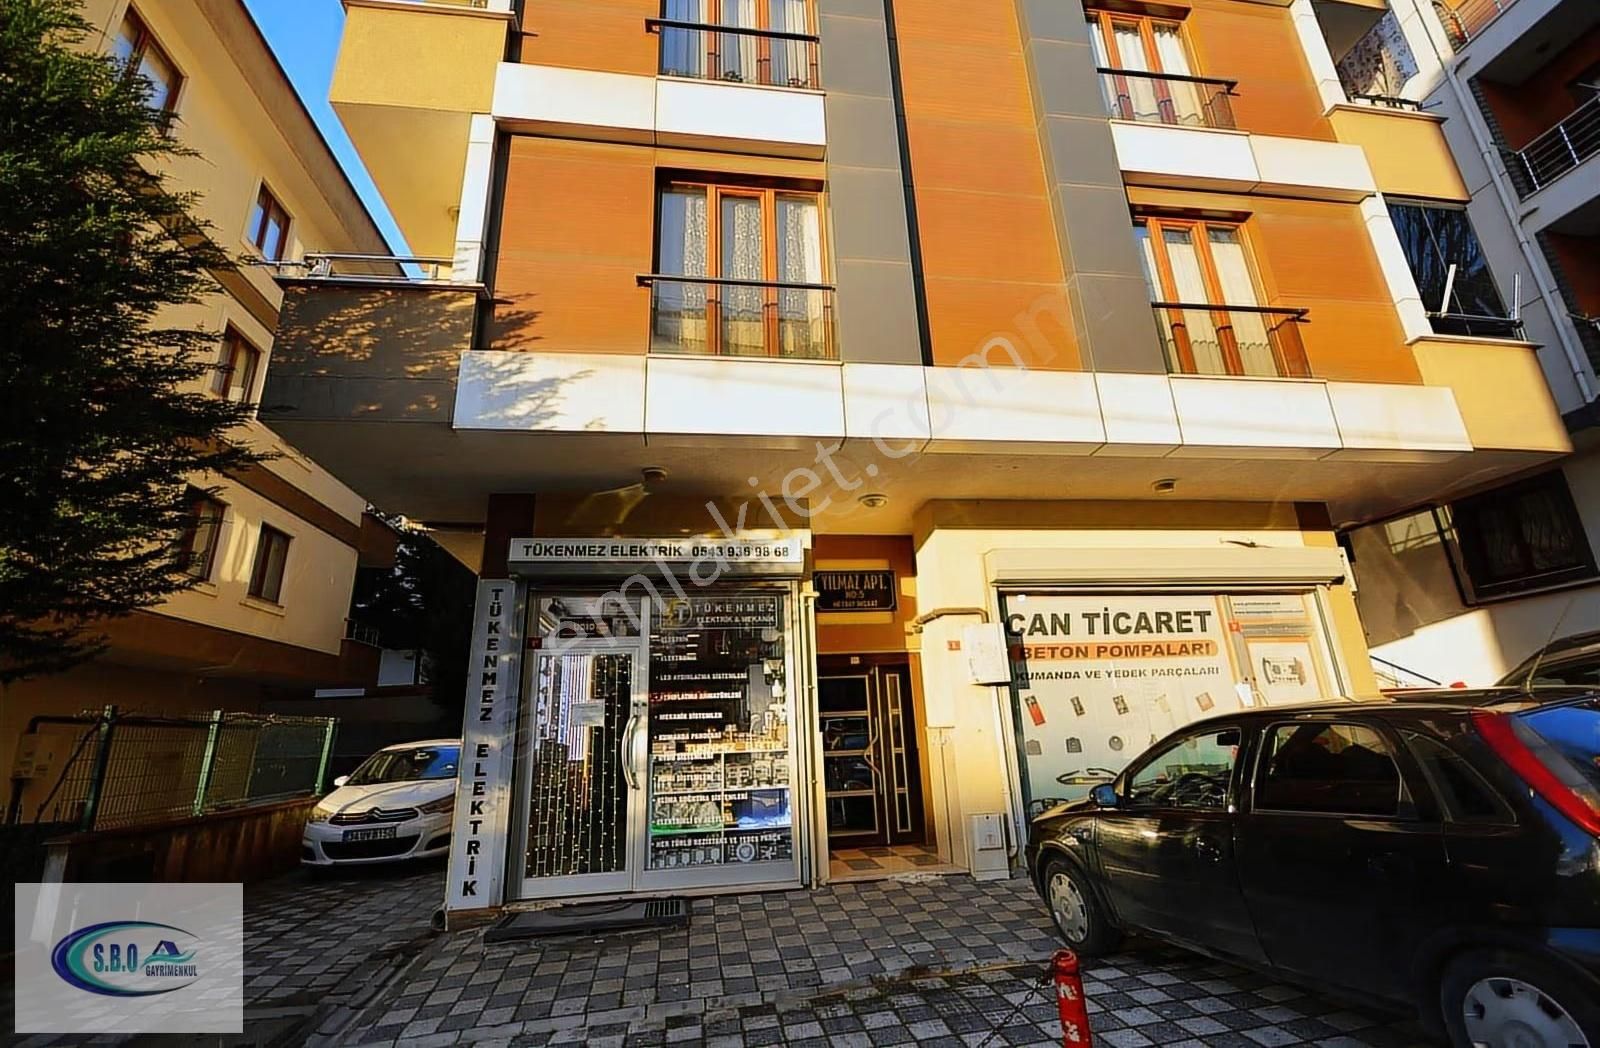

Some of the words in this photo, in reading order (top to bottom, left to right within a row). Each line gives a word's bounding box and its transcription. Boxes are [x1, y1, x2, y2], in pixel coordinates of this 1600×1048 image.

[523, 543, 606, 557] TÜKENMEZ
[610, 542, 682, 557] ELEKTRİK
[821, 574, 861, 590] YILMAZ
[863, 574, 888, 590] APT.
[695, 602, 776, 614] TÜKENMEZ
[1008, 612, 1071, 637] CAN
[1081, 606, 1212, 636] TİCARET
[479, 588, 504, 721] TÜKENMEZ
[1021, 645, 1090, 660] BETON
[1095, 642, 1211, 659] POMPALARI
[1016, 671, 1081, 682] KUMANDA
[1084, 669, 1103, 680] VE
[1105, 668, 1148, 679] YEDEK
[1151, 666, 1220, 678] PARÇALARI
[462, 743, 491, 897] ELEKTRİK
